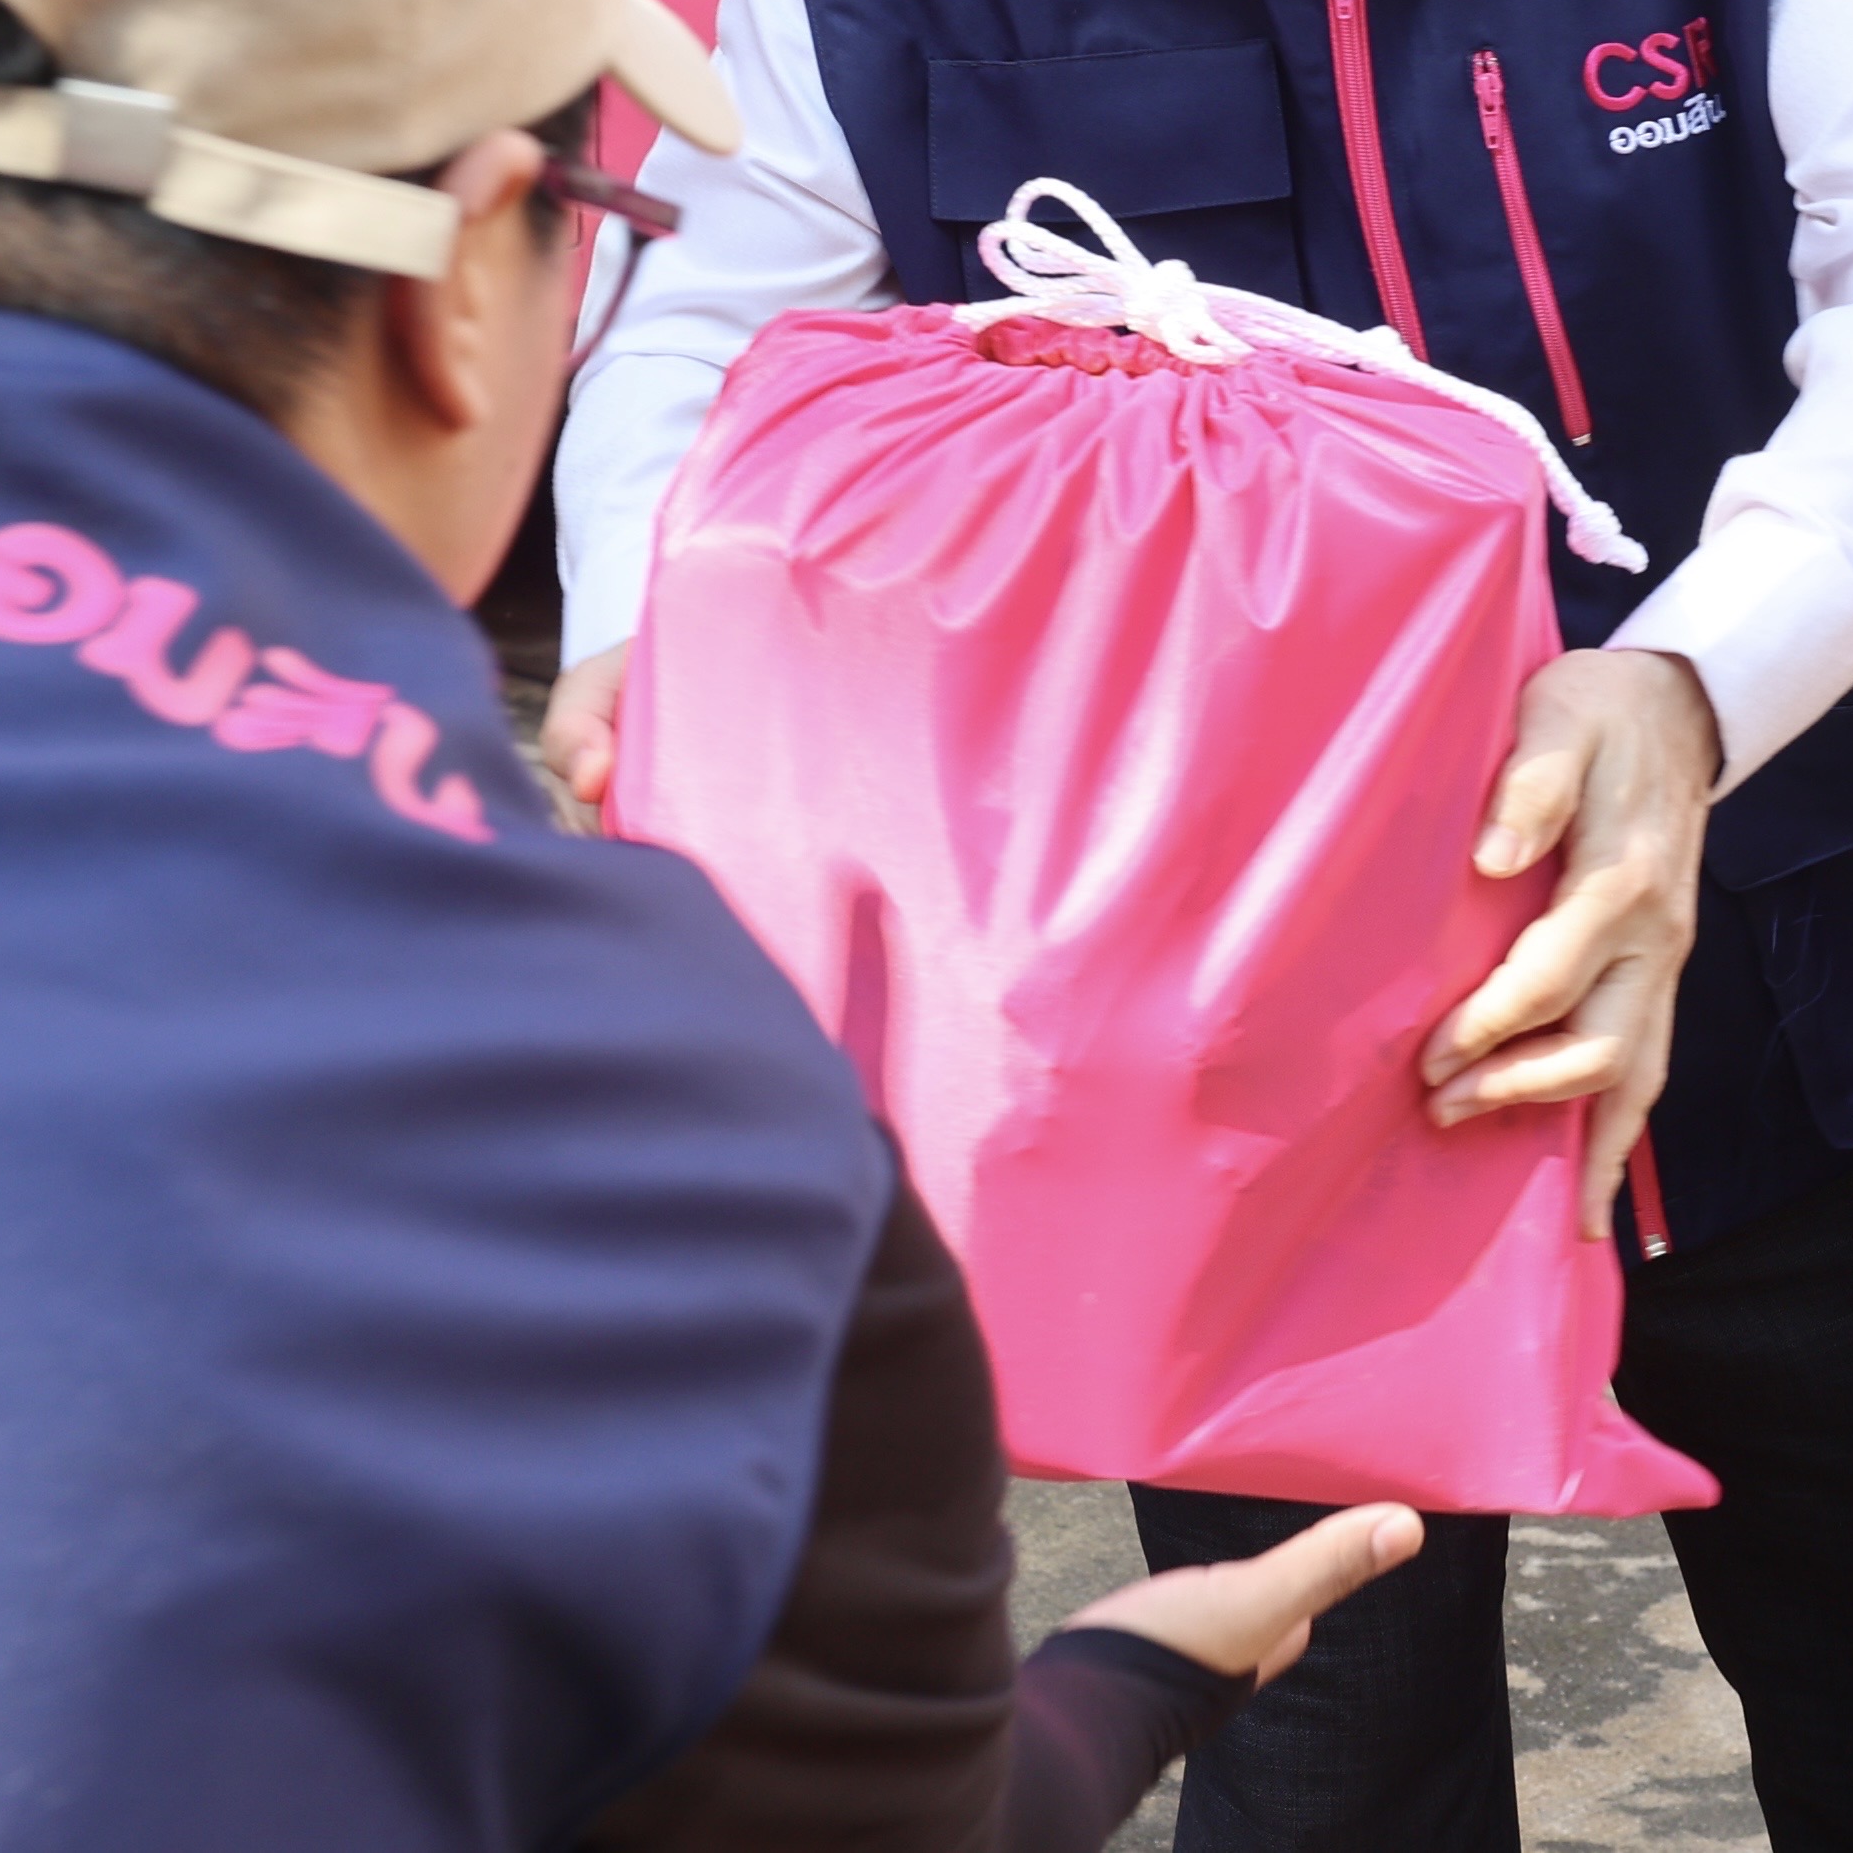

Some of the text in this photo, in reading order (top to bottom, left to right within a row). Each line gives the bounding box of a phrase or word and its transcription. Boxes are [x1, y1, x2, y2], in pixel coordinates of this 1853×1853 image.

[1582, 16, 1720, 113] CSR
[1608, 92, 1728, 155] ออมสิน
